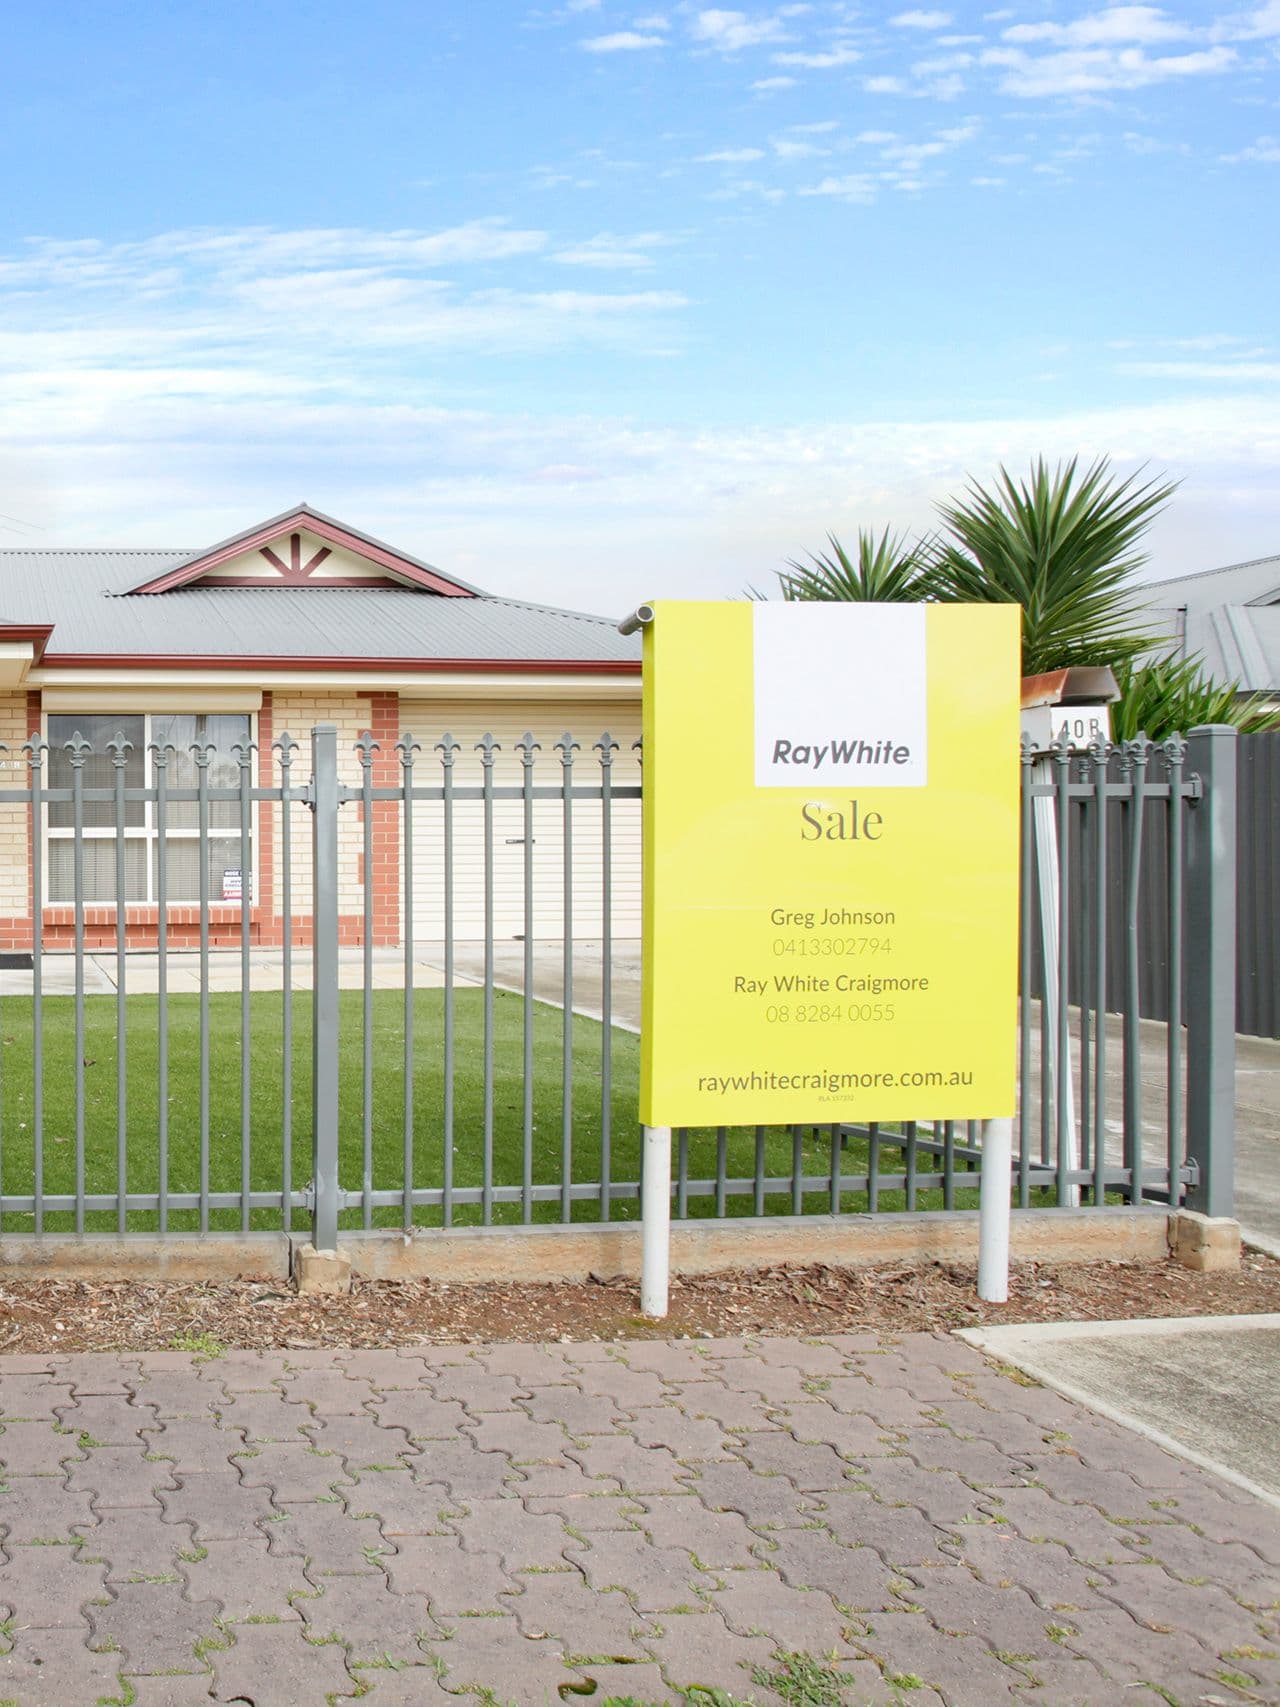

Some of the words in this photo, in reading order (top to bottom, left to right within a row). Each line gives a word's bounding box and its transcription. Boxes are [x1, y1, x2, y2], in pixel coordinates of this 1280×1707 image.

[801, 799, 883, 842] Sale
[771, 908, 815, 930] Greg
[820, 908, 896, 926] Johnson
[772, 938, 892, 957] 0413302794
[734, 976, 769, 996] Ray
[773, 975, 830, 993] White
[835, 974, 929, 995] Craigmore
[766, 1004, 790, 1023] 08
[795, 1004, 842, 1023] 8284
[848, 1004, 896, 1022] 0055
[698, 1069, 973, 1094] raywhitecraigmore.com.au
